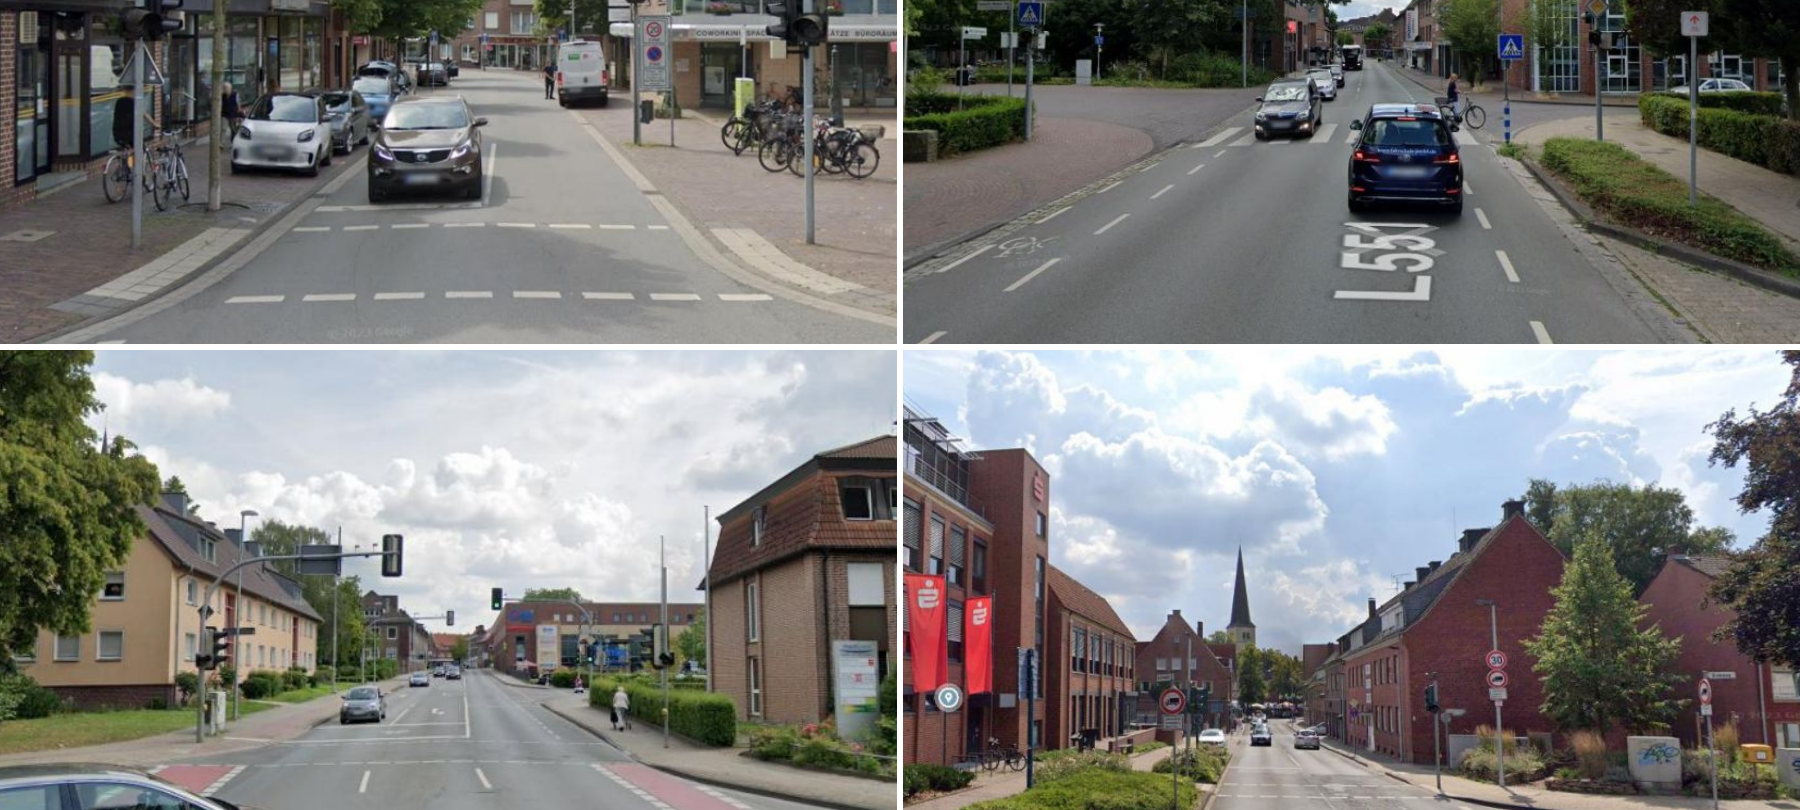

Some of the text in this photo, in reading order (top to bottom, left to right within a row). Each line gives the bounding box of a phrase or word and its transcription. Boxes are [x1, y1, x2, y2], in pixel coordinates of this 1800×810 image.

[830, 28, 849, 37] ÄTZE
[1333, 222, 1436, 301] L 551
[1491, 655, 1504, 665] 30
